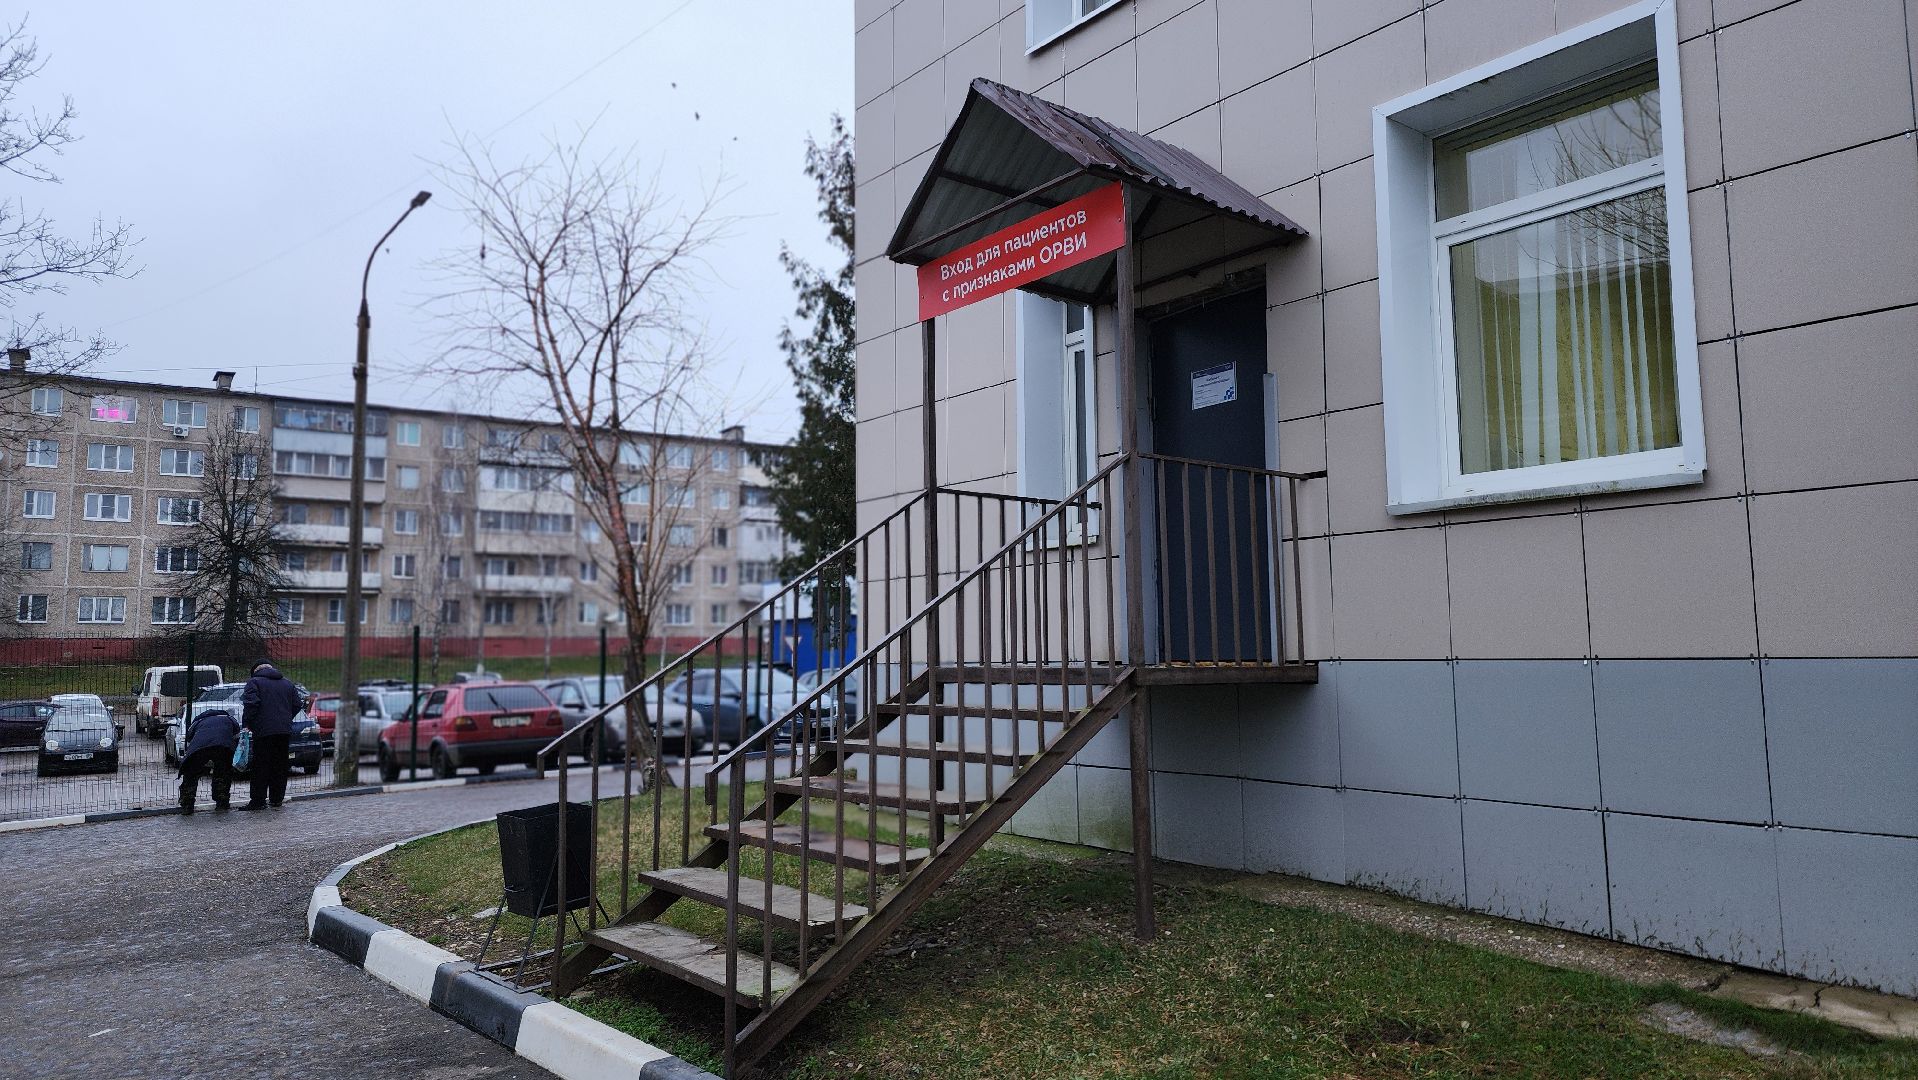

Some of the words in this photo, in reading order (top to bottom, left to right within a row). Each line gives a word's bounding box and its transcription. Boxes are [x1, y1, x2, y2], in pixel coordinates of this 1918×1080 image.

[940, 257, 974, 281] Вход
[976, 244, 1001, 269] для
[1004, 210, 1087, 254] пациентов
[942, 289, 950, 302] с
[953, 255, 1036, 299] признаками
[1039, 231, 1087, 264] ОРВИ
